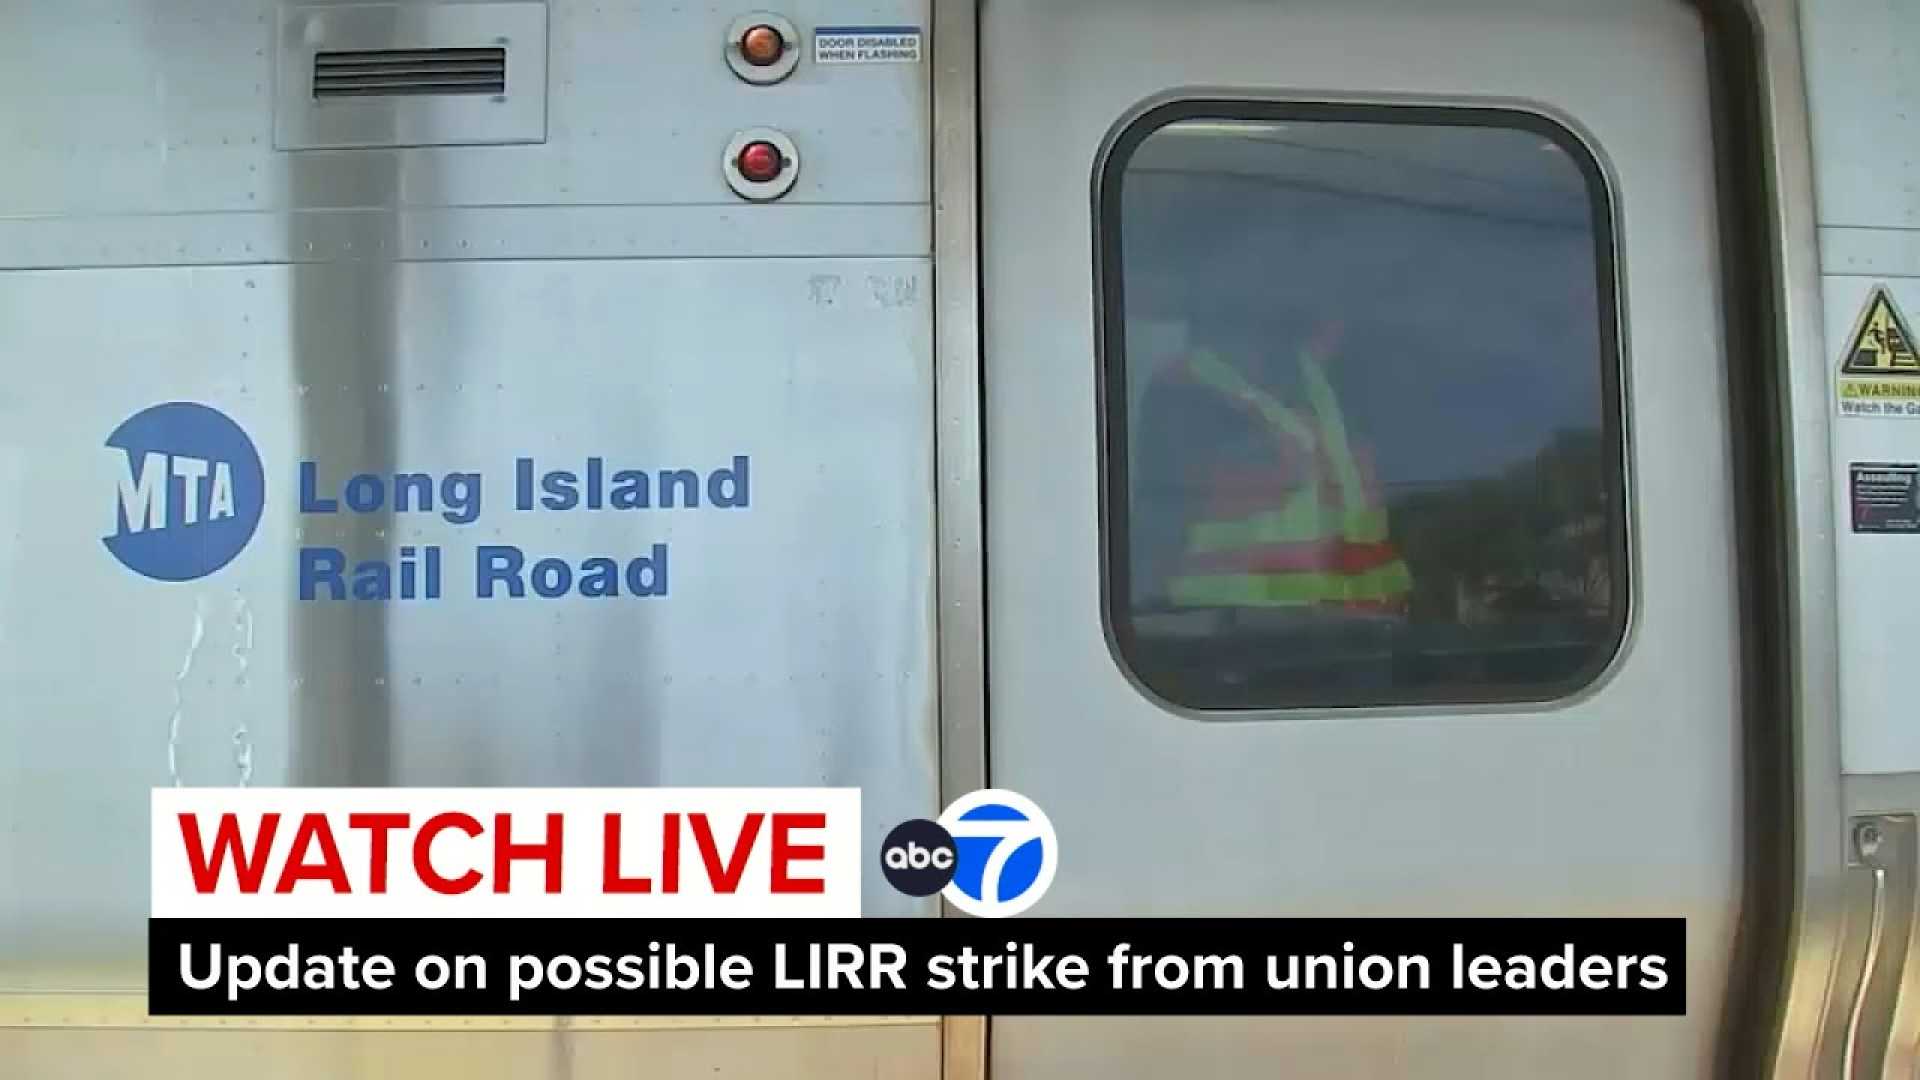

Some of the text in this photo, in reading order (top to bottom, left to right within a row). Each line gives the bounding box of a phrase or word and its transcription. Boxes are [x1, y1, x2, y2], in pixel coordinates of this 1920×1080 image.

[819, 37, 917, 49] DOOR DISABLED
[819, 49, 918, 60] WHEN FLASHING
[1841, 401, 1881, 414] Watch
[1883, 401, 1904, 414] the
[106, 447, 236, 534] MTA
[299, 455, 750, 525] Long Island
[299, 543, 669, 602] Rail Road
